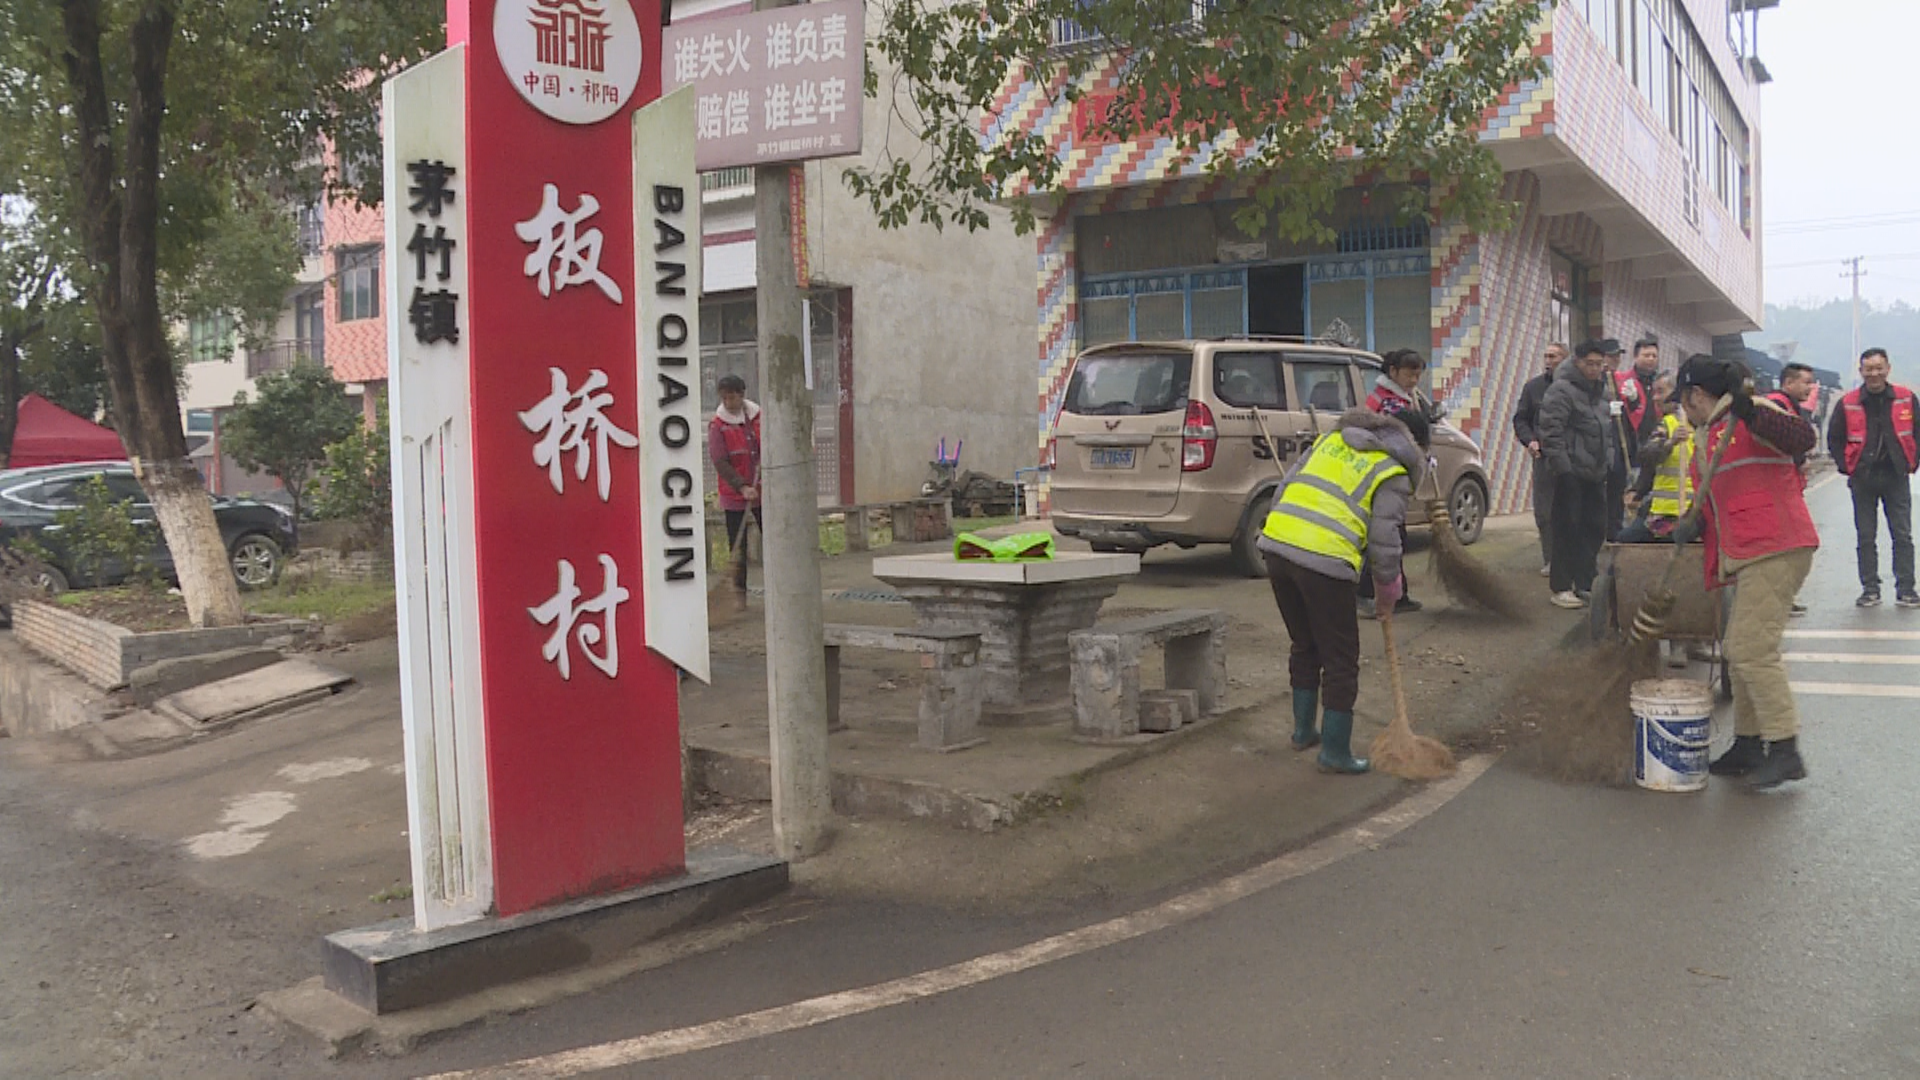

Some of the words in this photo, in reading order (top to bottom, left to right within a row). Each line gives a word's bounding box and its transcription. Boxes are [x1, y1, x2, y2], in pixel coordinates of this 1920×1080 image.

[523, 69, 619, 105] 中国·祁阳
[674, 29, 750, 82] 谁失火
[766, 13, 847, 70] 谁负责
[694, 89, 750, 141] 赔偿
[764, 76, 846, 131] 谁坐牢
[406, 159, 460, 346] 茅竹镇
[652, 184, 687, 297] BAN
[514, 183, 640, 681] 板桥村
[655, 313, 691, 450] QIAO
[661, 467, 695, 583] CUN
